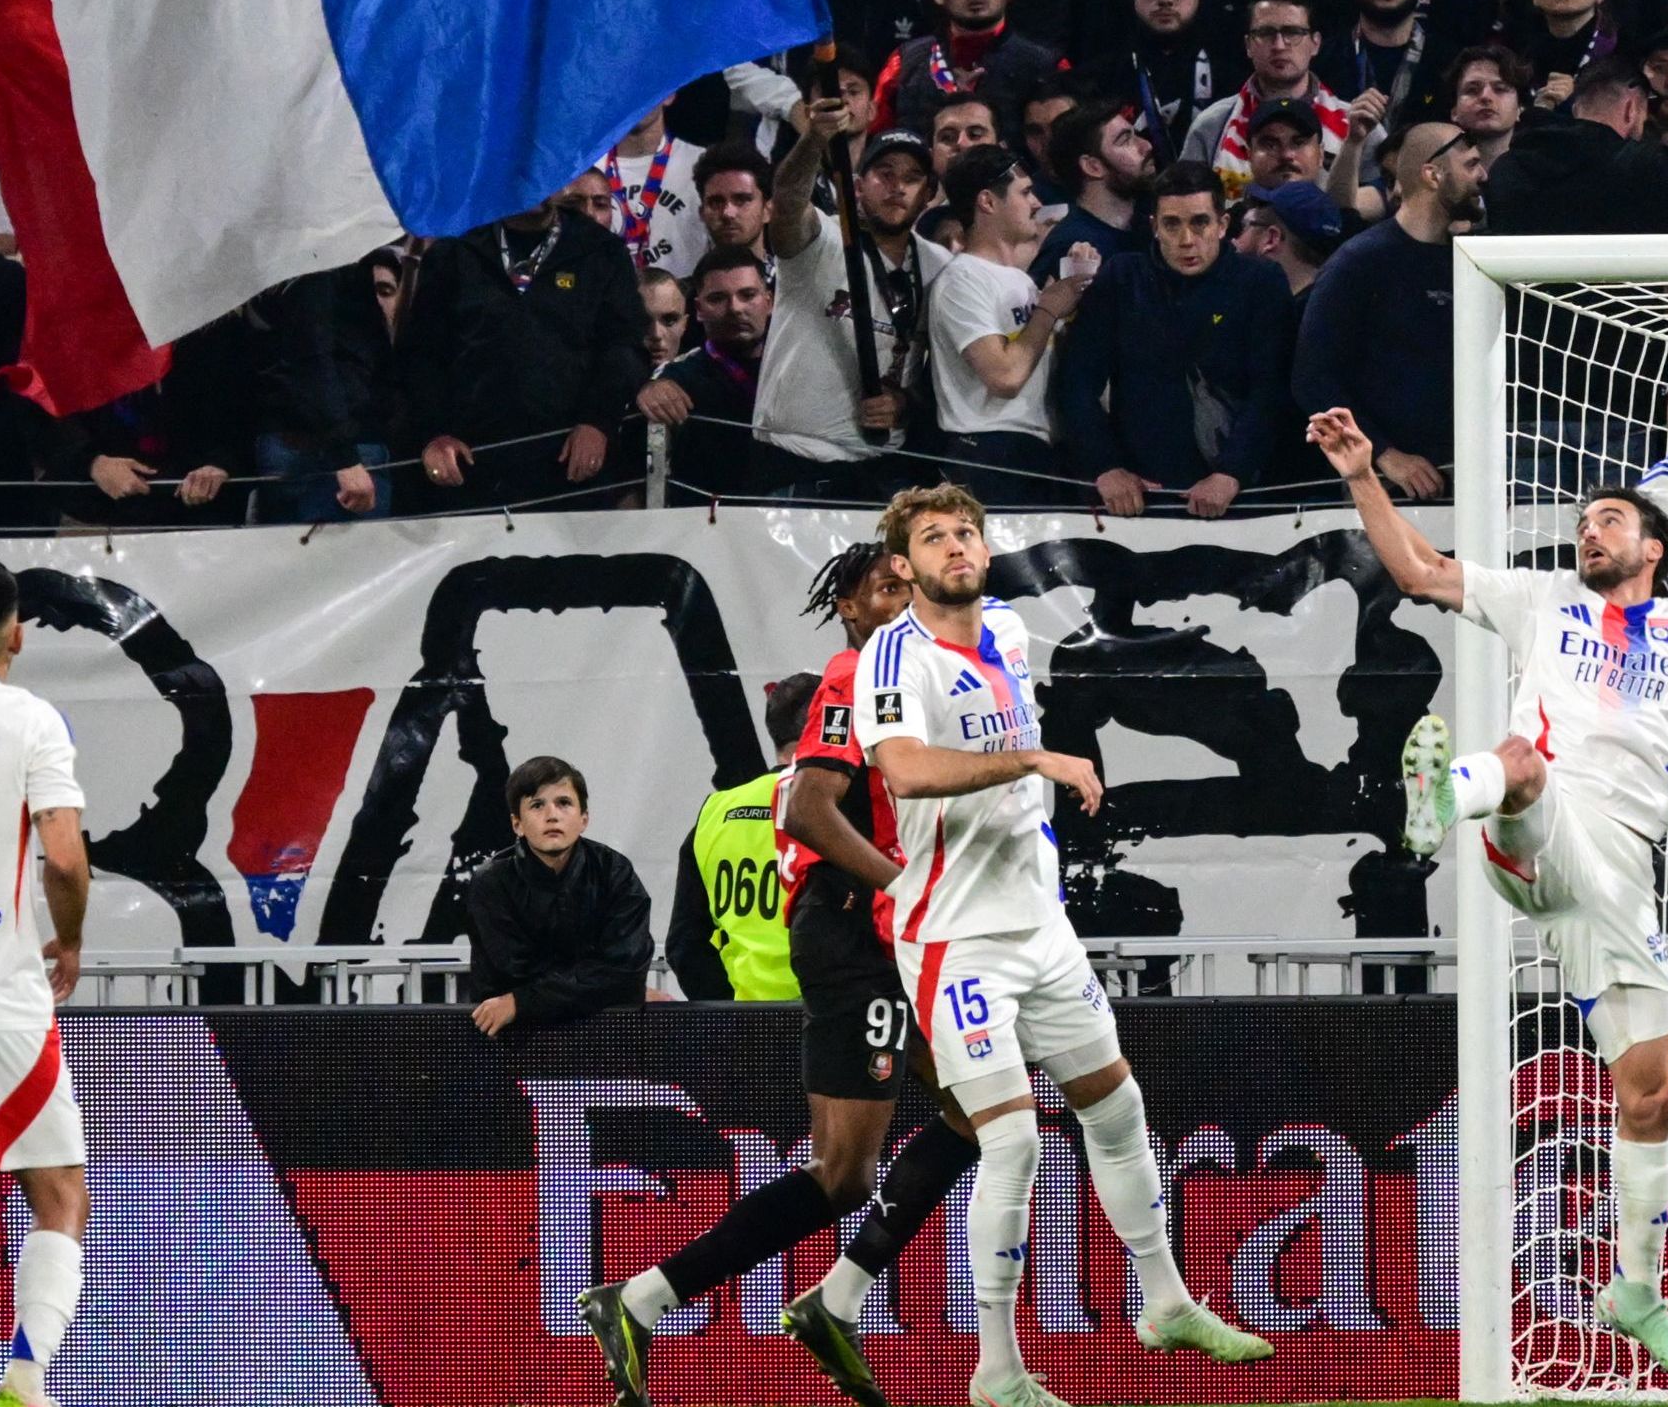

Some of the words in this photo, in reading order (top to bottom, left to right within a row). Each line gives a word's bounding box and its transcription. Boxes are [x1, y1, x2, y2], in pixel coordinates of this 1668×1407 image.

[1574, 660, 1605, 686] FLY
[1606, 667, 1665, 703] BETTER
[714, 857, 779, 921] 060
[865, 997, 909, 1052] 97
[944, 978, 989, 1031] 15
